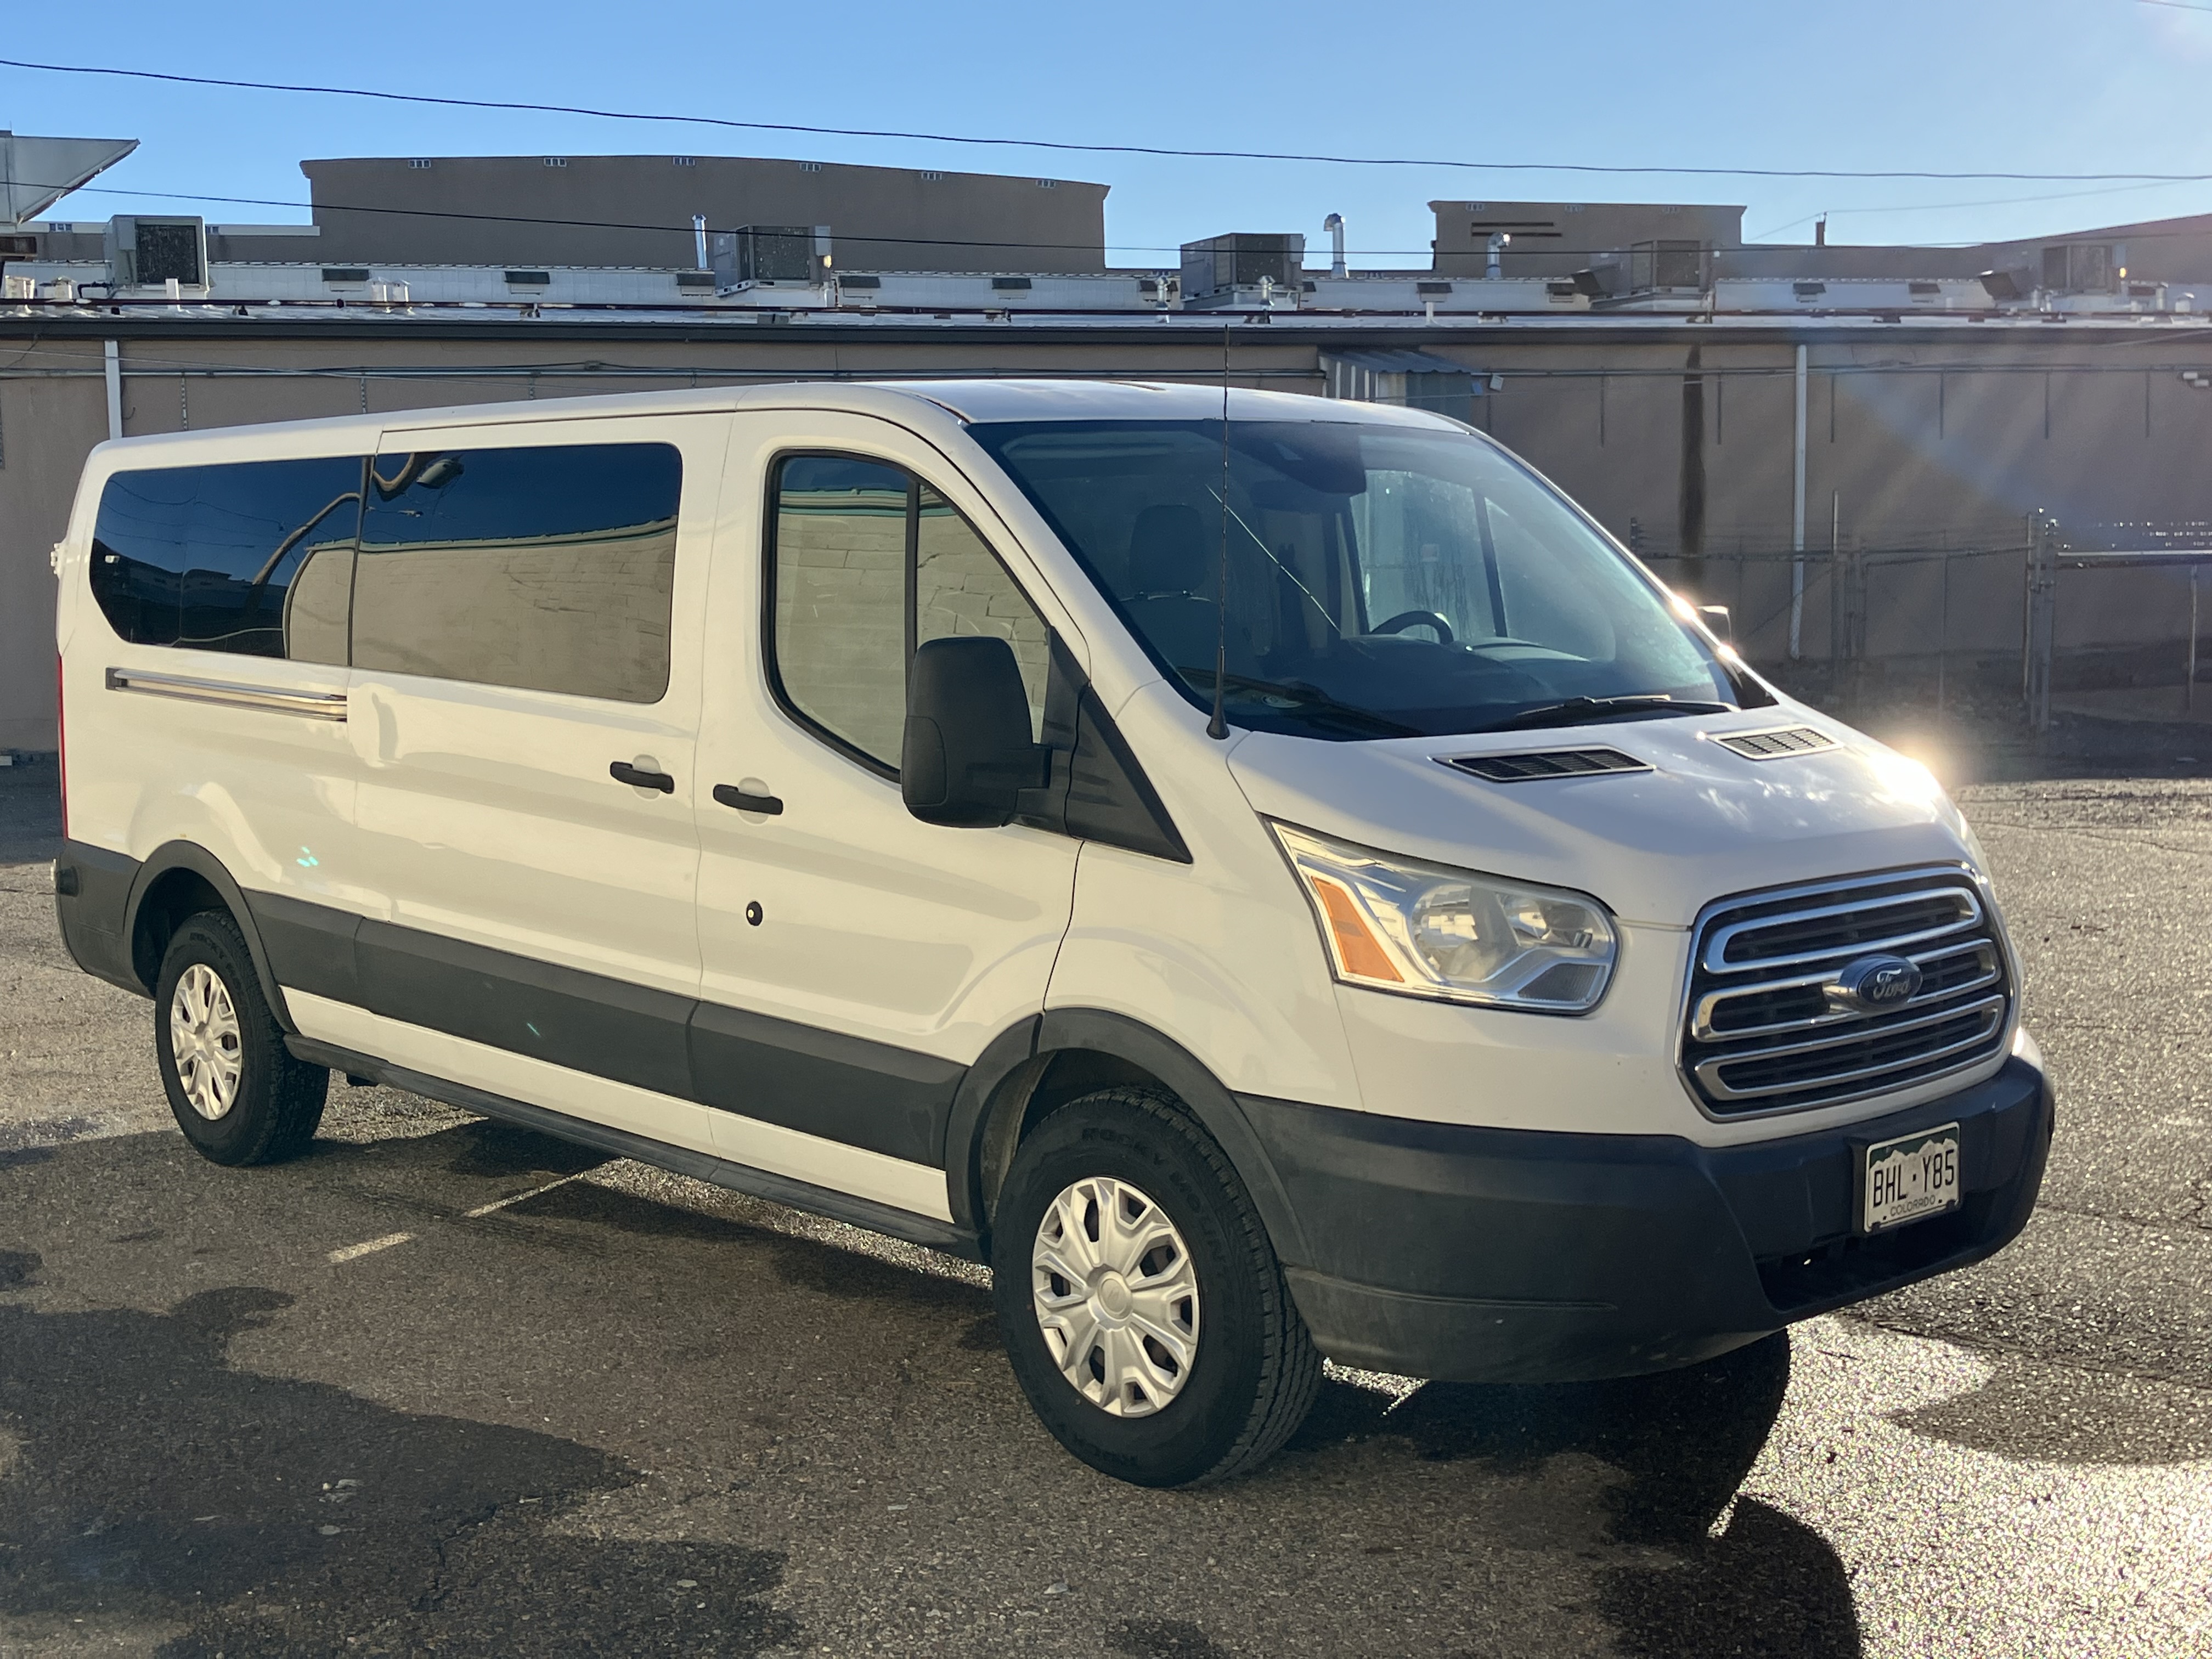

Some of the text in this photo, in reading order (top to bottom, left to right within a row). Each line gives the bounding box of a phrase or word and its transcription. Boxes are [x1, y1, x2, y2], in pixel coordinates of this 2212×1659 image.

[1872, 968, 1911, 1001] Ford
[1081, 1127, 1166, 1166] ROCKY
[1890, 1195, 1936, 1217] COLORADO
